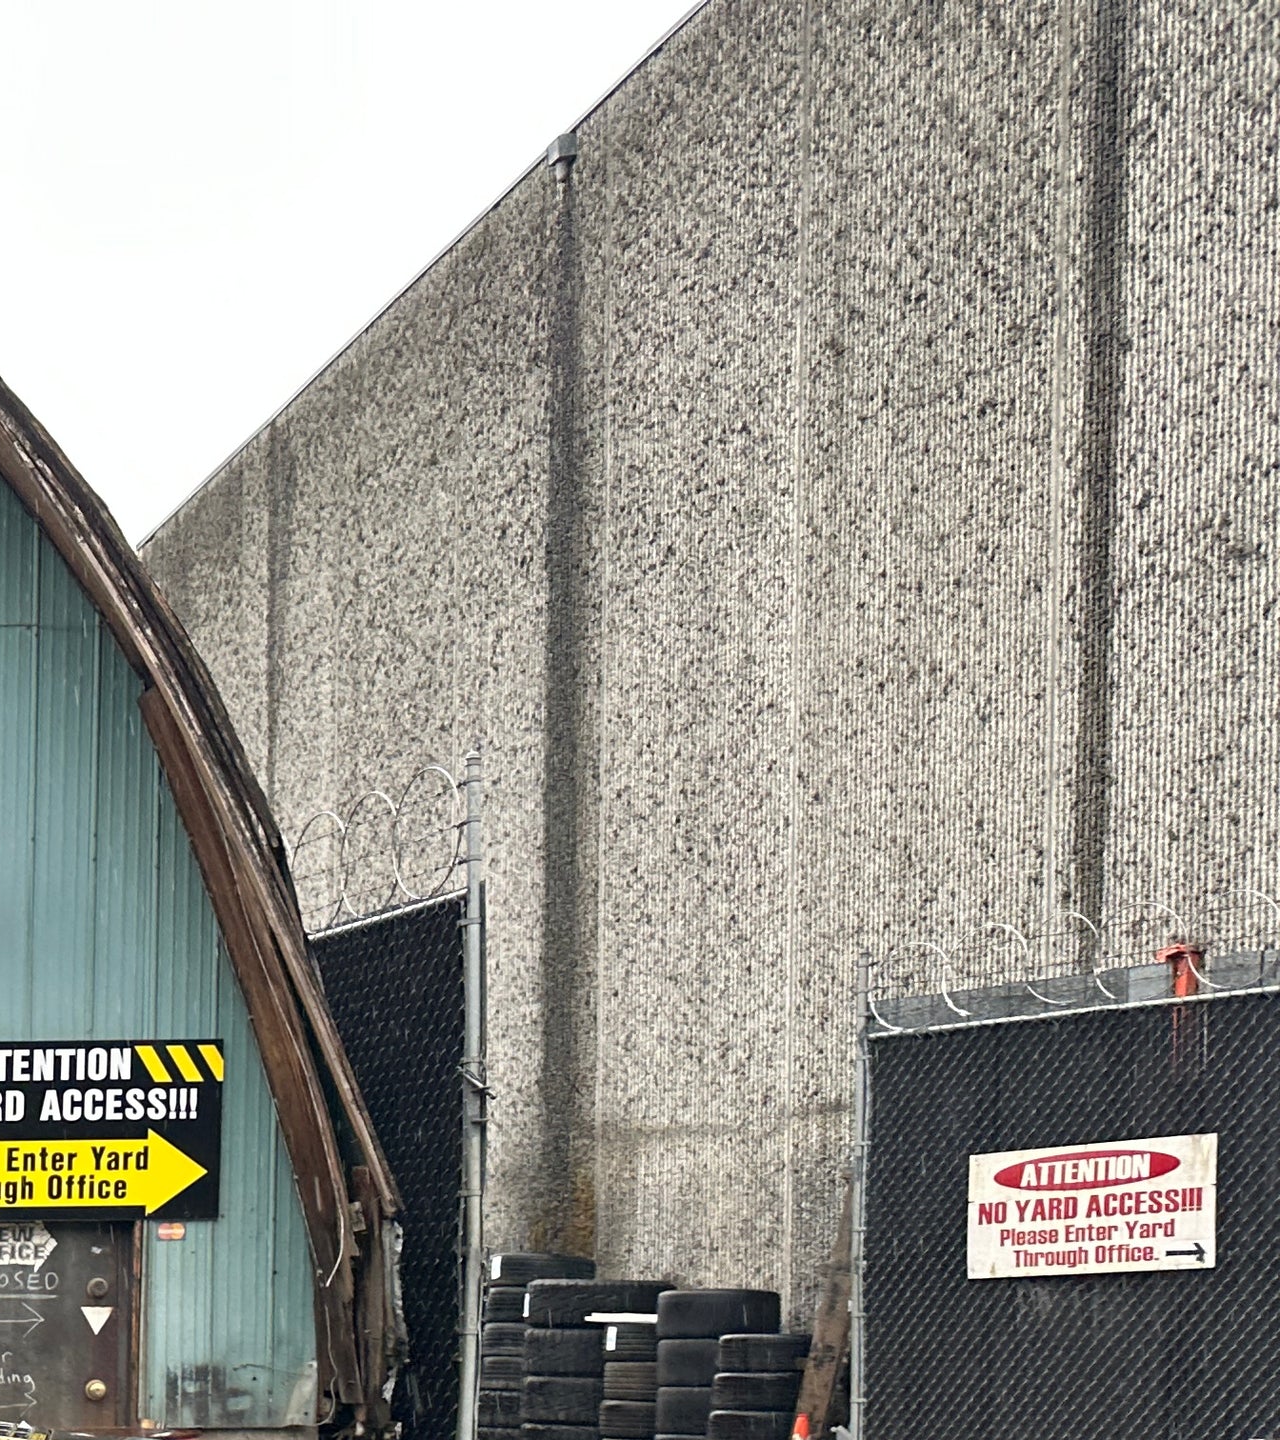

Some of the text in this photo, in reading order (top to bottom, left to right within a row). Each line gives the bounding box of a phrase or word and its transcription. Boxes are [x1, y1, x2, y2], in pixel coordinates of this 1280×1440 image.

[39, 1087, 198, 1121] ACCESS!!!
[6, 1147, 78, 1171] Enter
[91, 1145, 150, 1170] Yard
[1020, 1152, 1151, 1188] ATTENTION
[47, 1175, 128, 1199] Office
[978, 1187, 1203, 1226] NO YARD ACCESS!!!
[999, 1219, 1175, 1247] Please Enter Yard
[1013, 1247, 1089, 1268] Through
